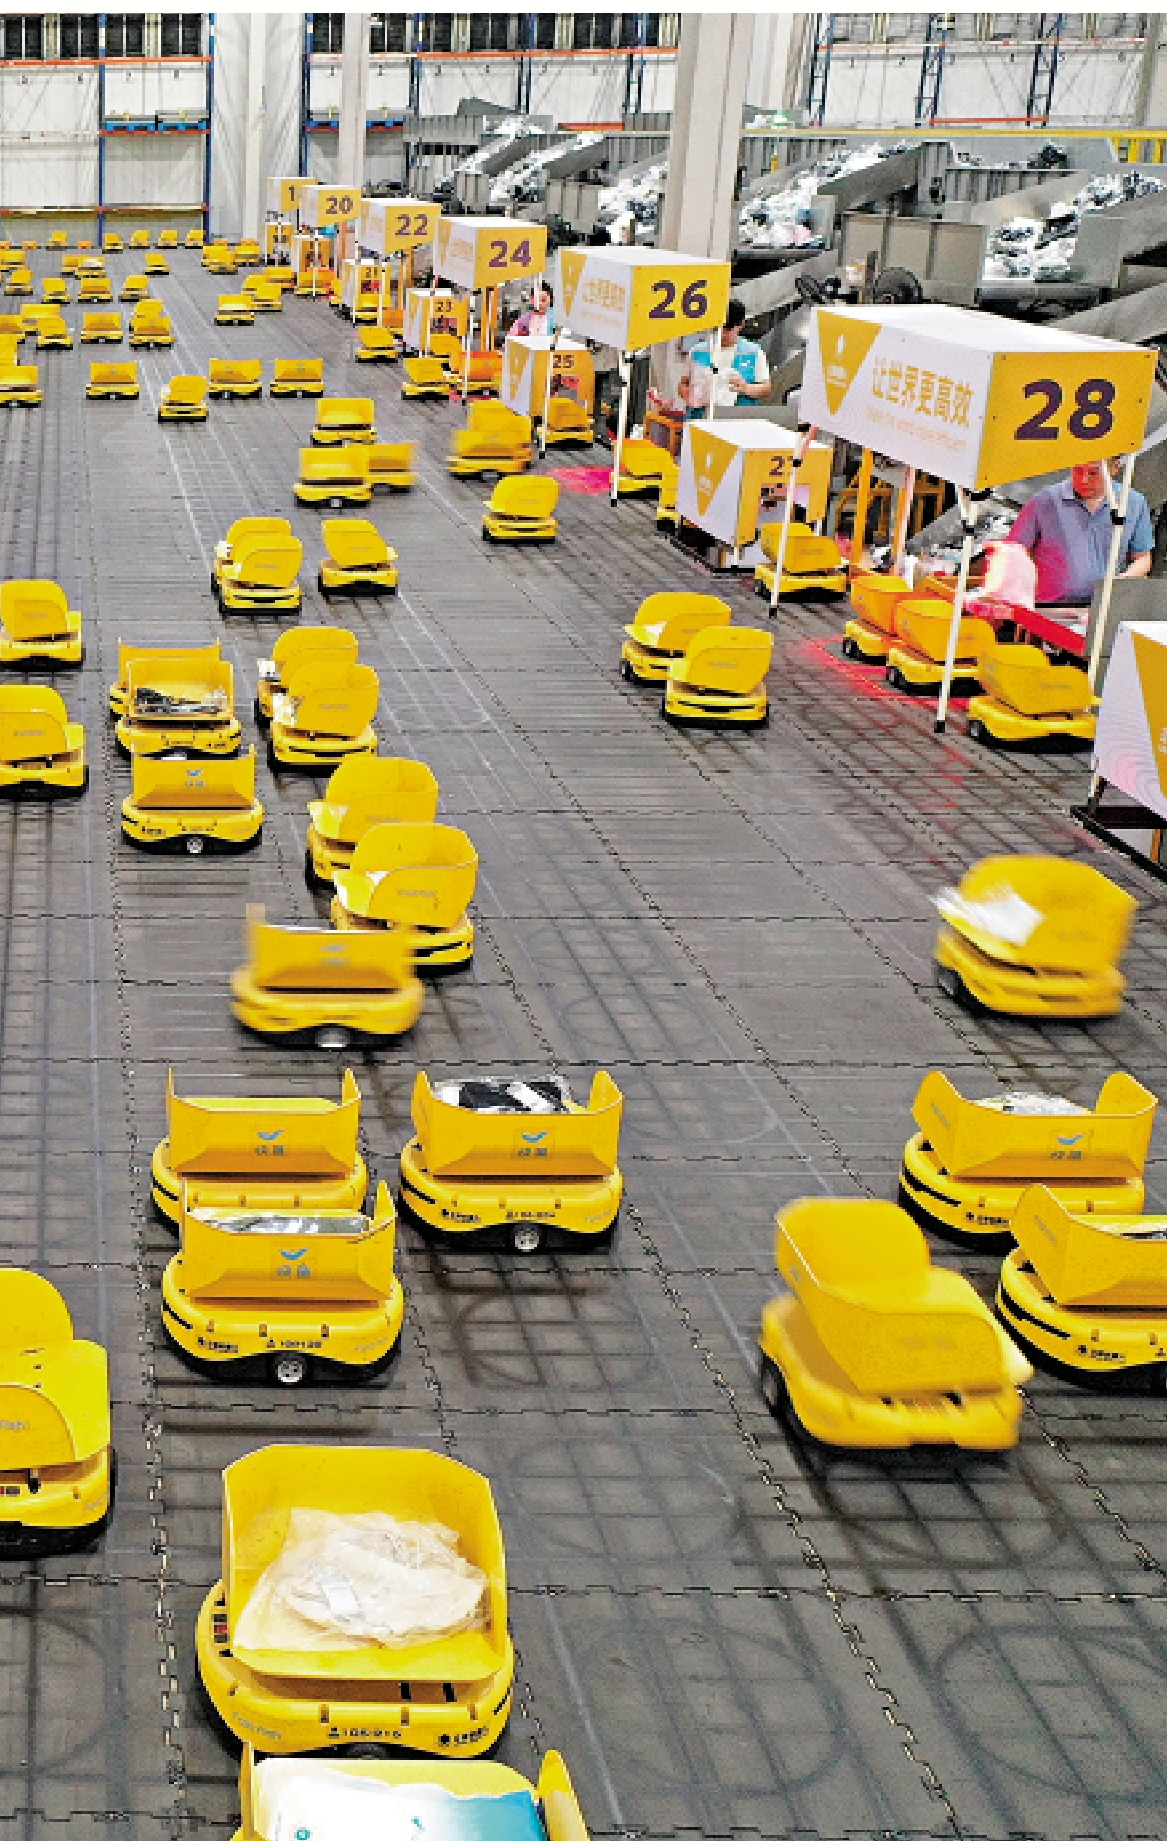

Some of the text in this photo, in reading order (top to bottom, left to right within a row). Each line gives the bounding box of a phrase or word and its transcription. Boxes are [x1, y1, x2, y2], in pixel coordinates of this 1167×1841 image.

[325, 195, 354, 215] 20
[394, 213, 429, 236] 22
[488, 240, 532, 268] 24
[648, 279, 709, 319] 26
[552, 354, 575, 369] 25
[1013, 378, 1116, 441] 28
